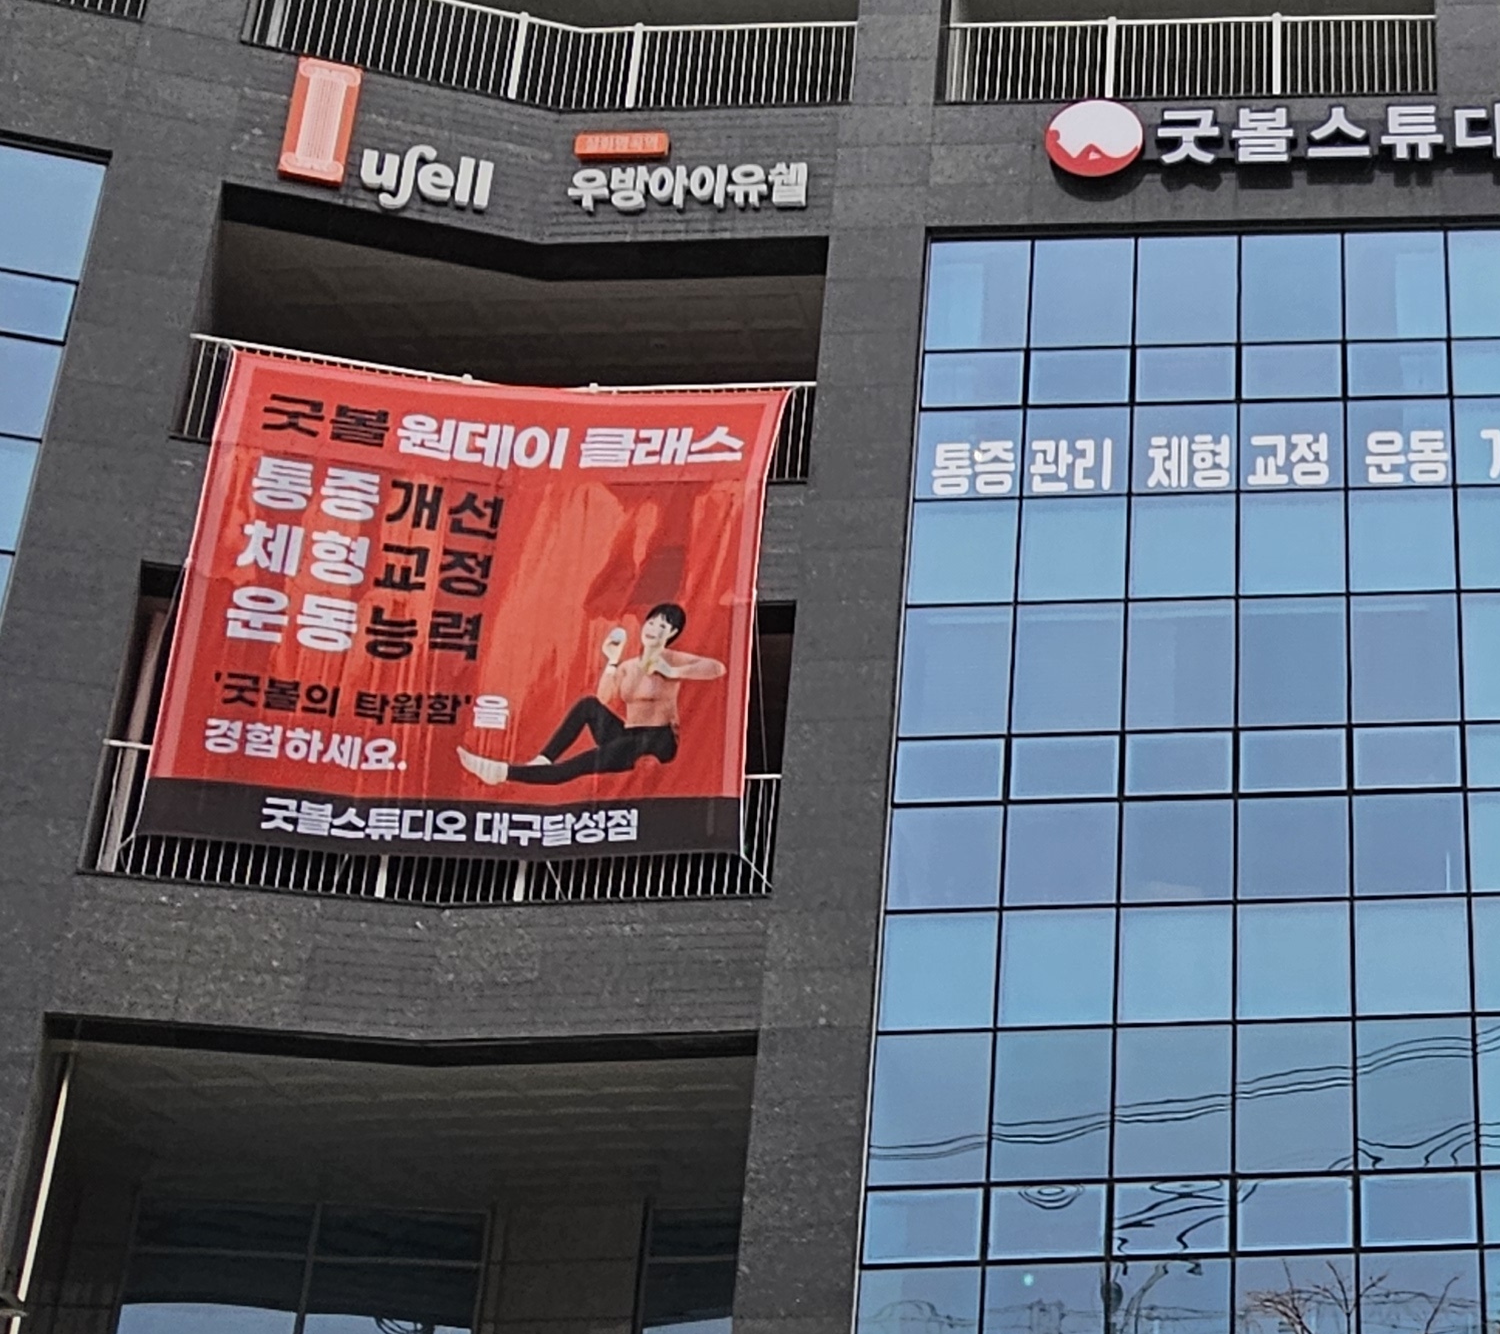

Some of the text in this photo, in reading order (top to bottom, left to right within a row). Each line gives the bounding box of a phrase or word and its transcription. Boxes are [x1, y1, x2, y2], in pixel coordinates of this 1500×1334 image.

[568, 162, 808, 212] 우방아이유쉘
[262, 393, 747, 471] 굿볼 원데이 클래스
[931, 439, 1016, 496] 통증
[1029, 437, 1113, 492] 관리
[1146, 433, 1231, 490] 체형
[1246, 431, 1330, 487] 교정
[1364, 429, 1450, 485] 운동
[203, 718, 408, 772] 경험하세요.
[260, 796, 638, 847] 굿볼스튜디오 대구달성점
